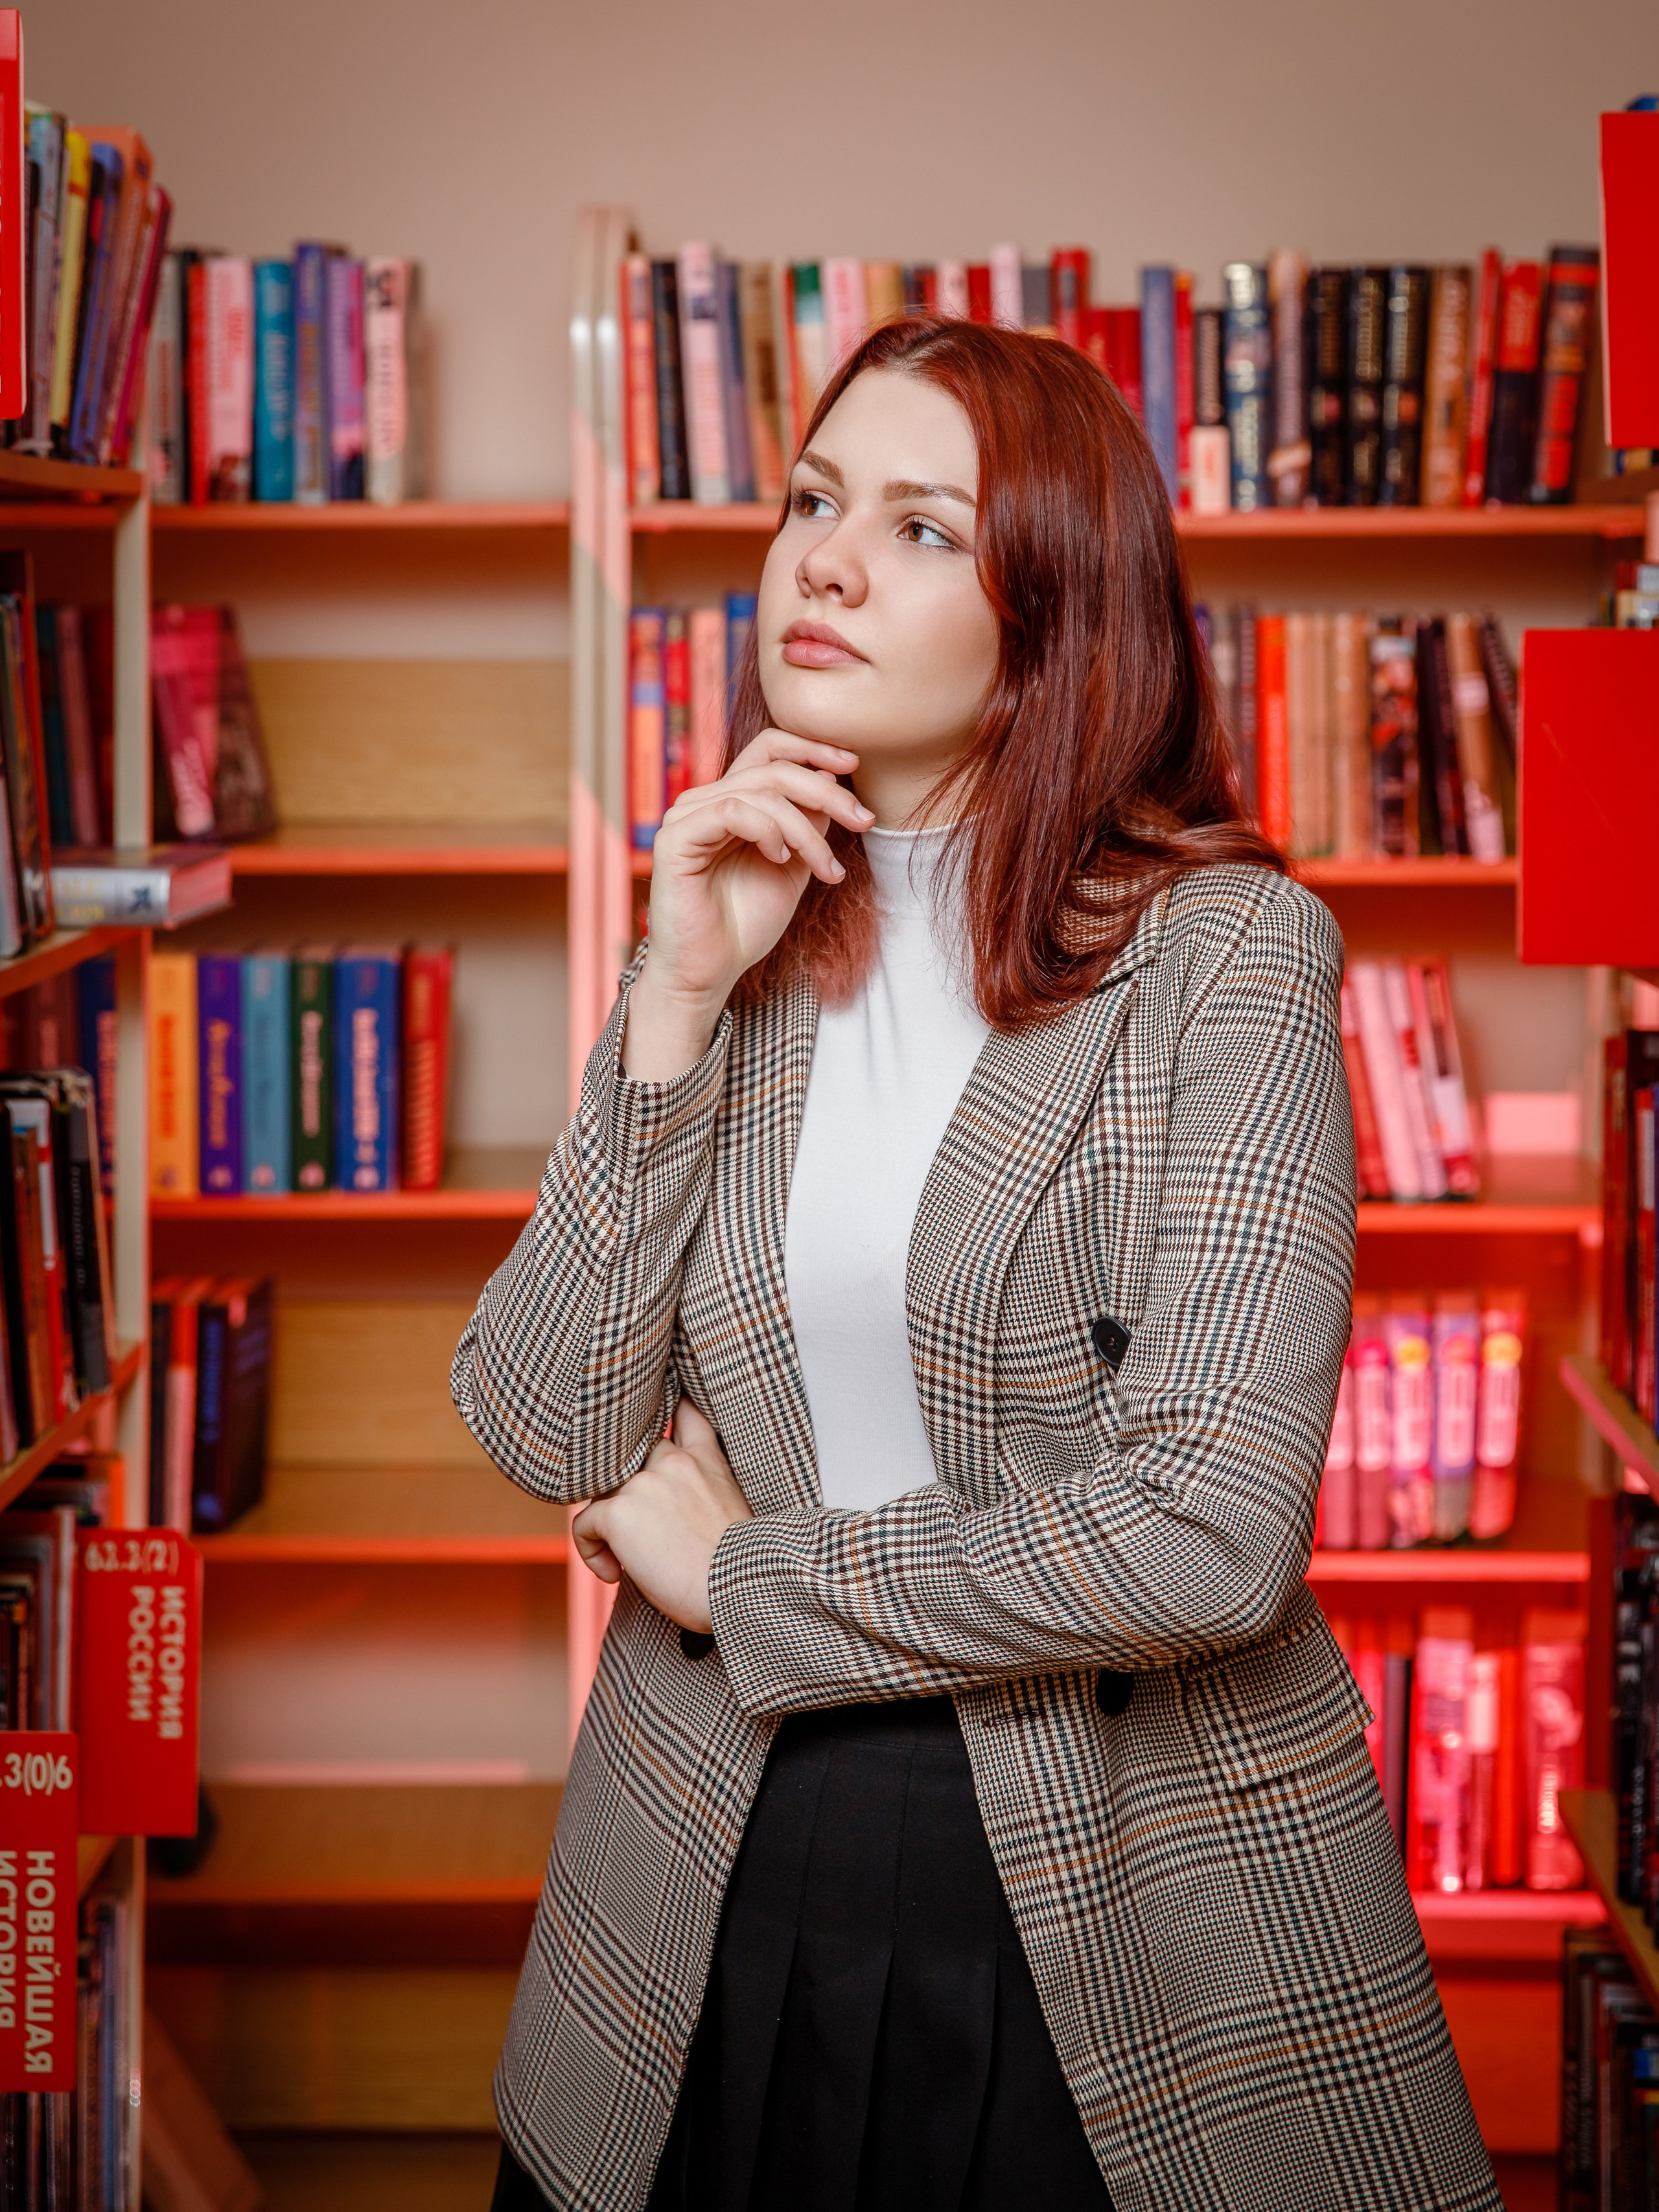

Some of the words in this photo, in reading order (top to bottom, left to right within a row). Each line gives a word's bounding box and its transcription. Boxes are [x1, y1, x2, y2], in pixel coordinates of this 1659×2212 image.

[128, 1585, 155, 1721] РОССИИ
[158, 1585, 186, 1739] ИСТОРИЯ
[25, 1850, 61, 2073] НОВЕЙШАЯ
